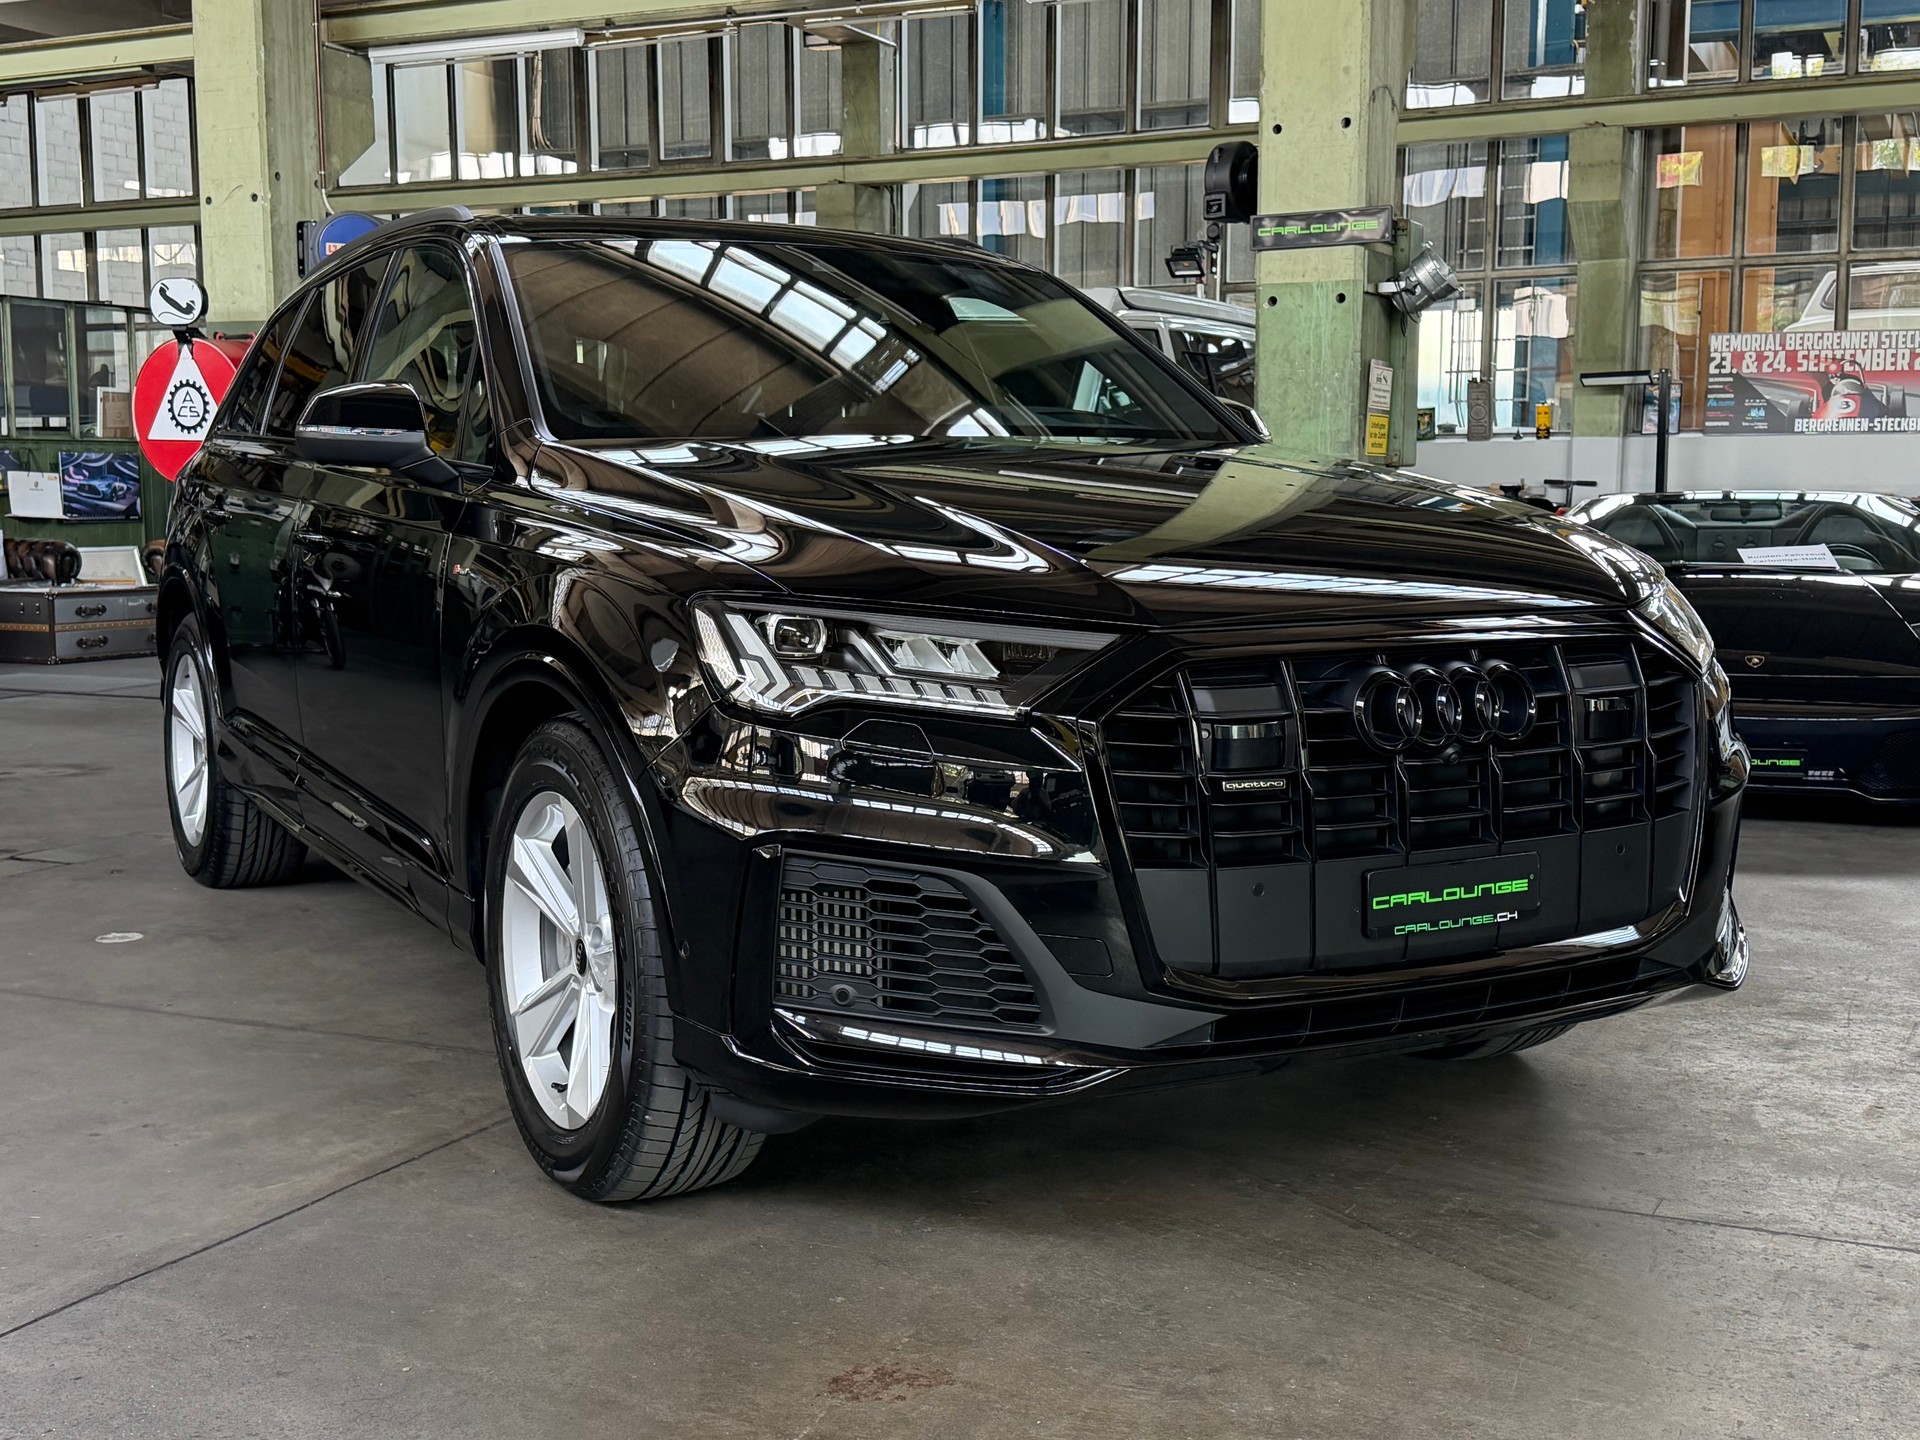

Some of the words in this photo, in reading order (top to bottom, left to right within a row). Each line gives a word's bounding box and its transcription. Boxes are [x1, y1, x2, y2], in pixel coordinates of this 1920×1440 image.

[1257, 220, 1379, 237] CARLOUNGE
[1710, 334, 1783, 352] MEMORIAL
[1785, 331, 1879, 351] BERGRENNEN
[1708, 351, 1738, 375] 23.
[1742, 351, 1758, 374] &
[1761, 351, 1792, 373] 24.
[1796, 348, 1911, 373] SEPTEMBER
[182, 390, 195, 404] A
[1794, 417, 1920, 432] BERGRENNEN-STECKB
[1225, 781, 1284, 790] quattro
[1372, 878, 1529, 910] CARLOUNGE
[1394, 910, 1518, 936] CARLOUNGE.CH
[622, 978, 634, 1051] SPORT
